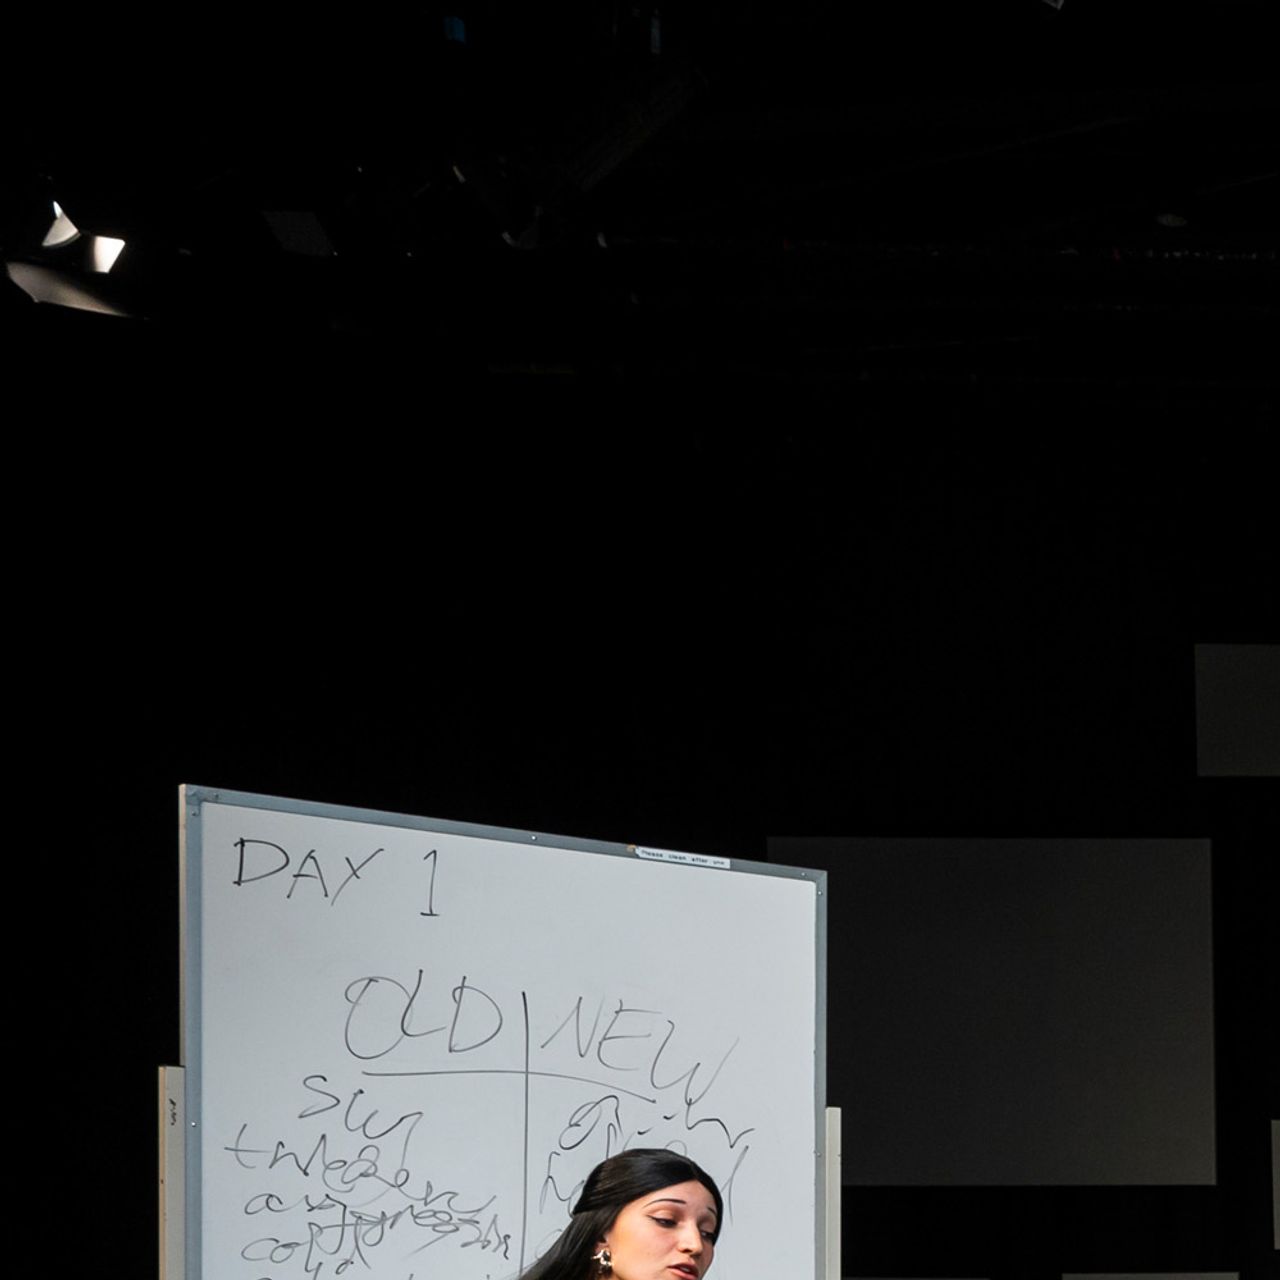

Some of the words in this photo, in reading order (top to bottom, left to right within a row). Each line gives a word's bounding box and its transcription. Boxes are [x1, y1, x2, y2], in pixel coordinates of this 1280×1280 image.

[232, 837, 386, 906] DAY
[420, 848, 441, 917] 1
[344, 969, 503, 1060] OLD
[540, 996, 741, 1106] NEW
